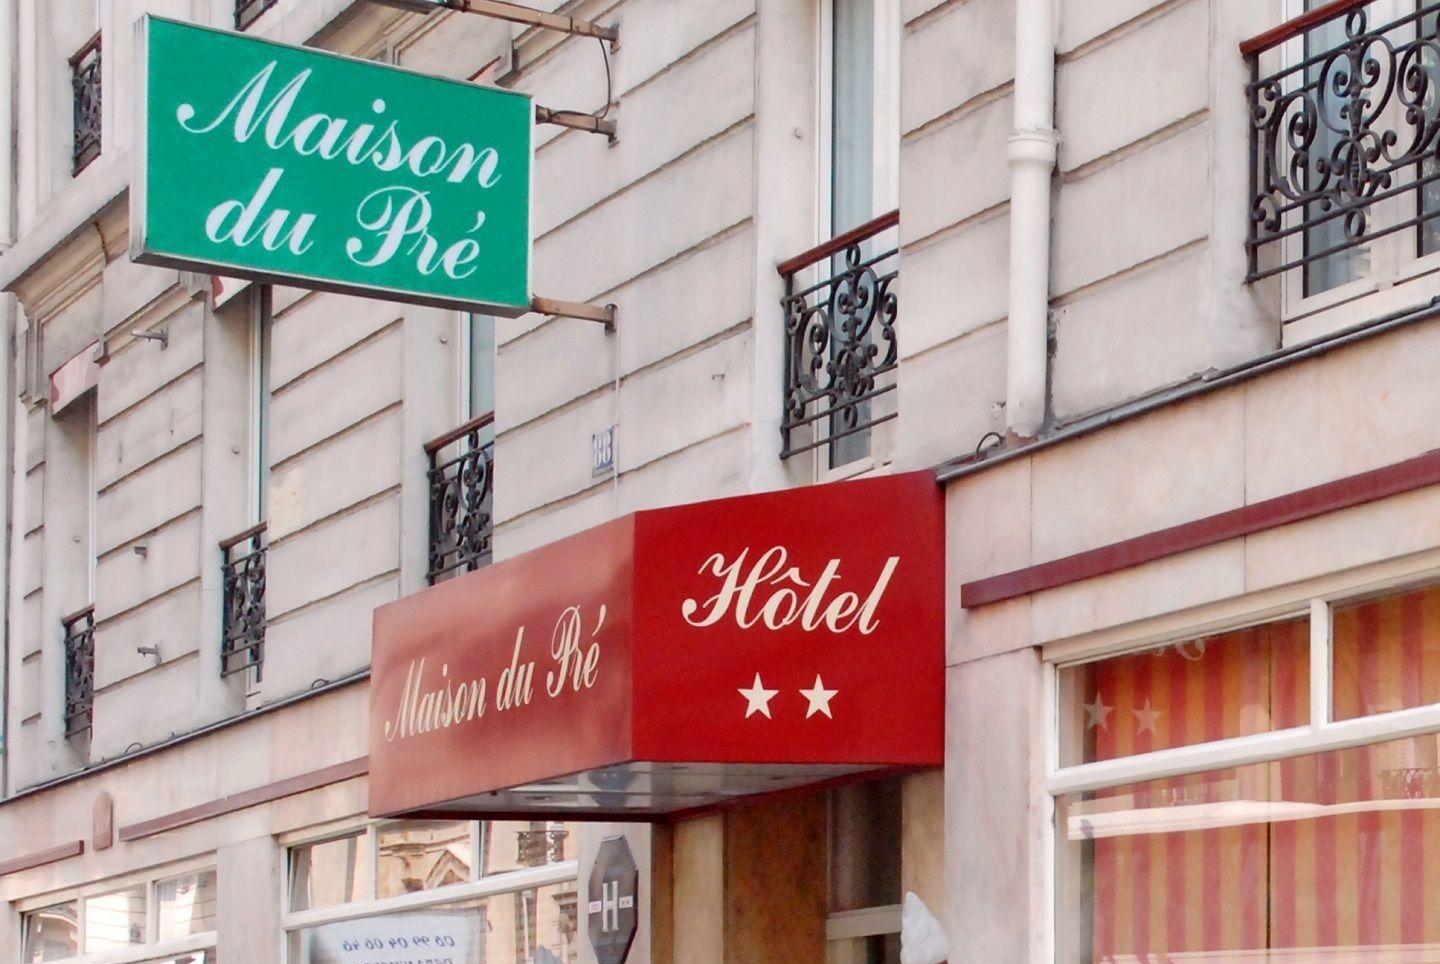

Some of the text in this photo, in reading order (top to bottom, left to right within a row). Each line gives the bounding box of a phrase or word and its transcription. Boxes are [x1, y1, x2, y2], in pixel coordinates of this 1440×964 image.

[177, 60, 501, 188] Maison
[206, 168, 486, 280] du Pré
[594, 432, 612, 468] 88
[682, 546, 900, 635] Hôtel
[385, 604, 607, 742] Maison du Pré
[602, 881, 619, 932] H
